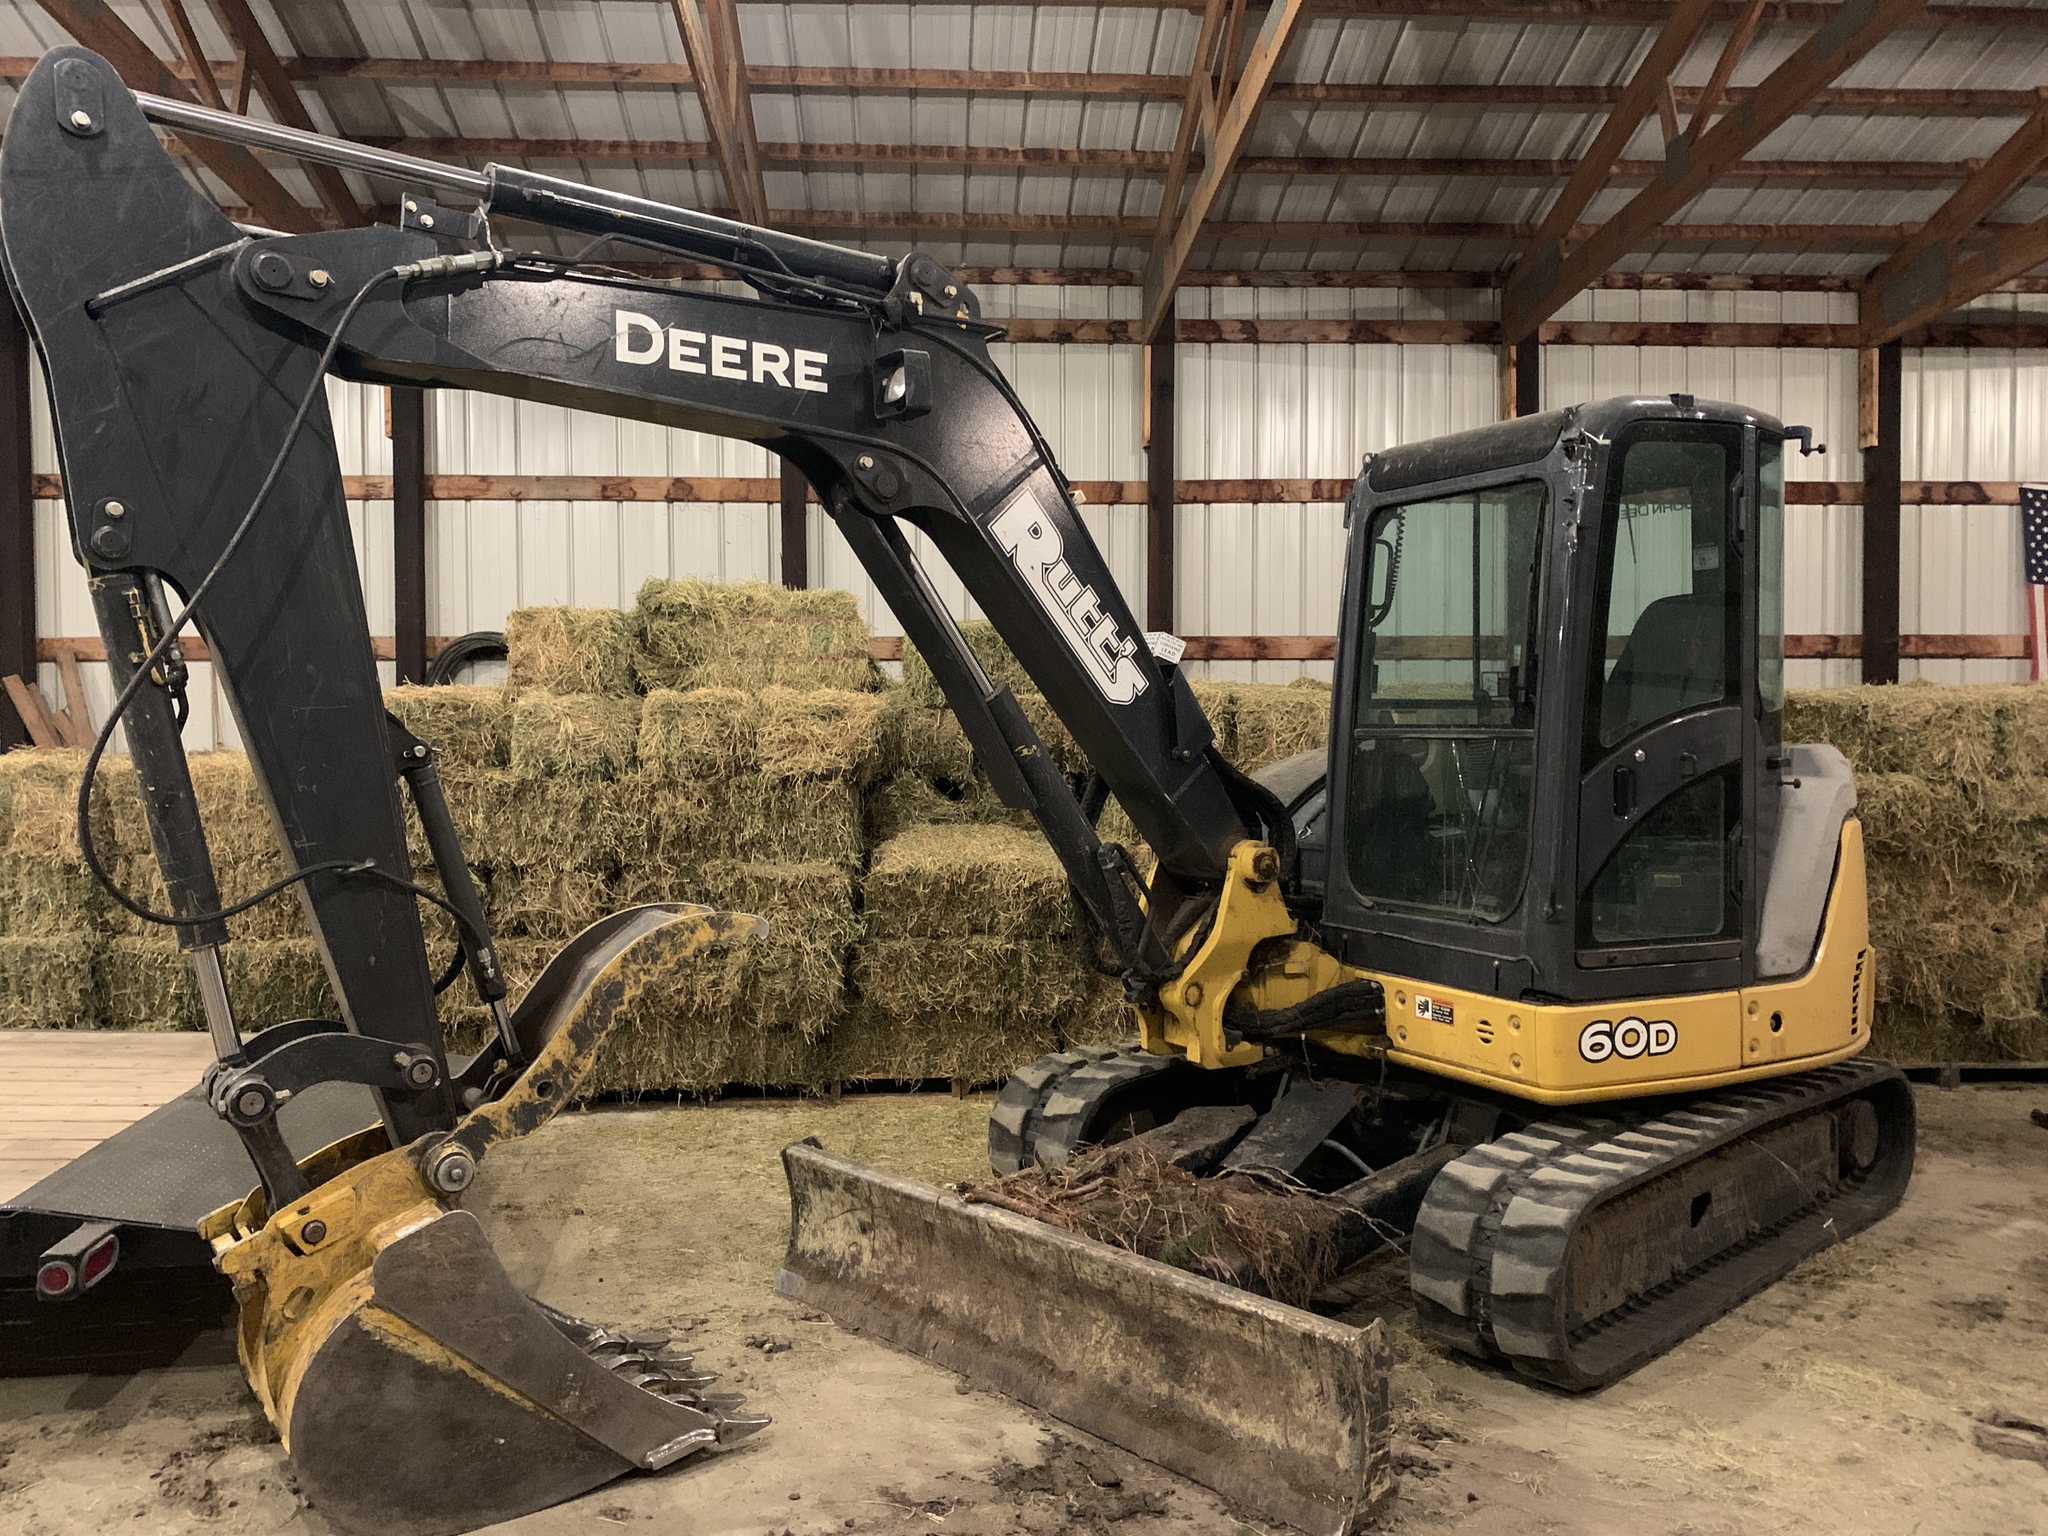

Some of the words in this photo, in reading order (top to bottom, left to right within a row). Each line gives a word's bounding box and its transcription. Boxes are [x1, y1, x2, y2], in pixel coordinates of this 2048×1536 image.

[615, 309, 828, 393] DEERE
[1160, 640, 1181, 652] CONTAINS
[1161, 647, 1176, 656] LEAD
[1578, 1016, 1678, 1063] 60D
